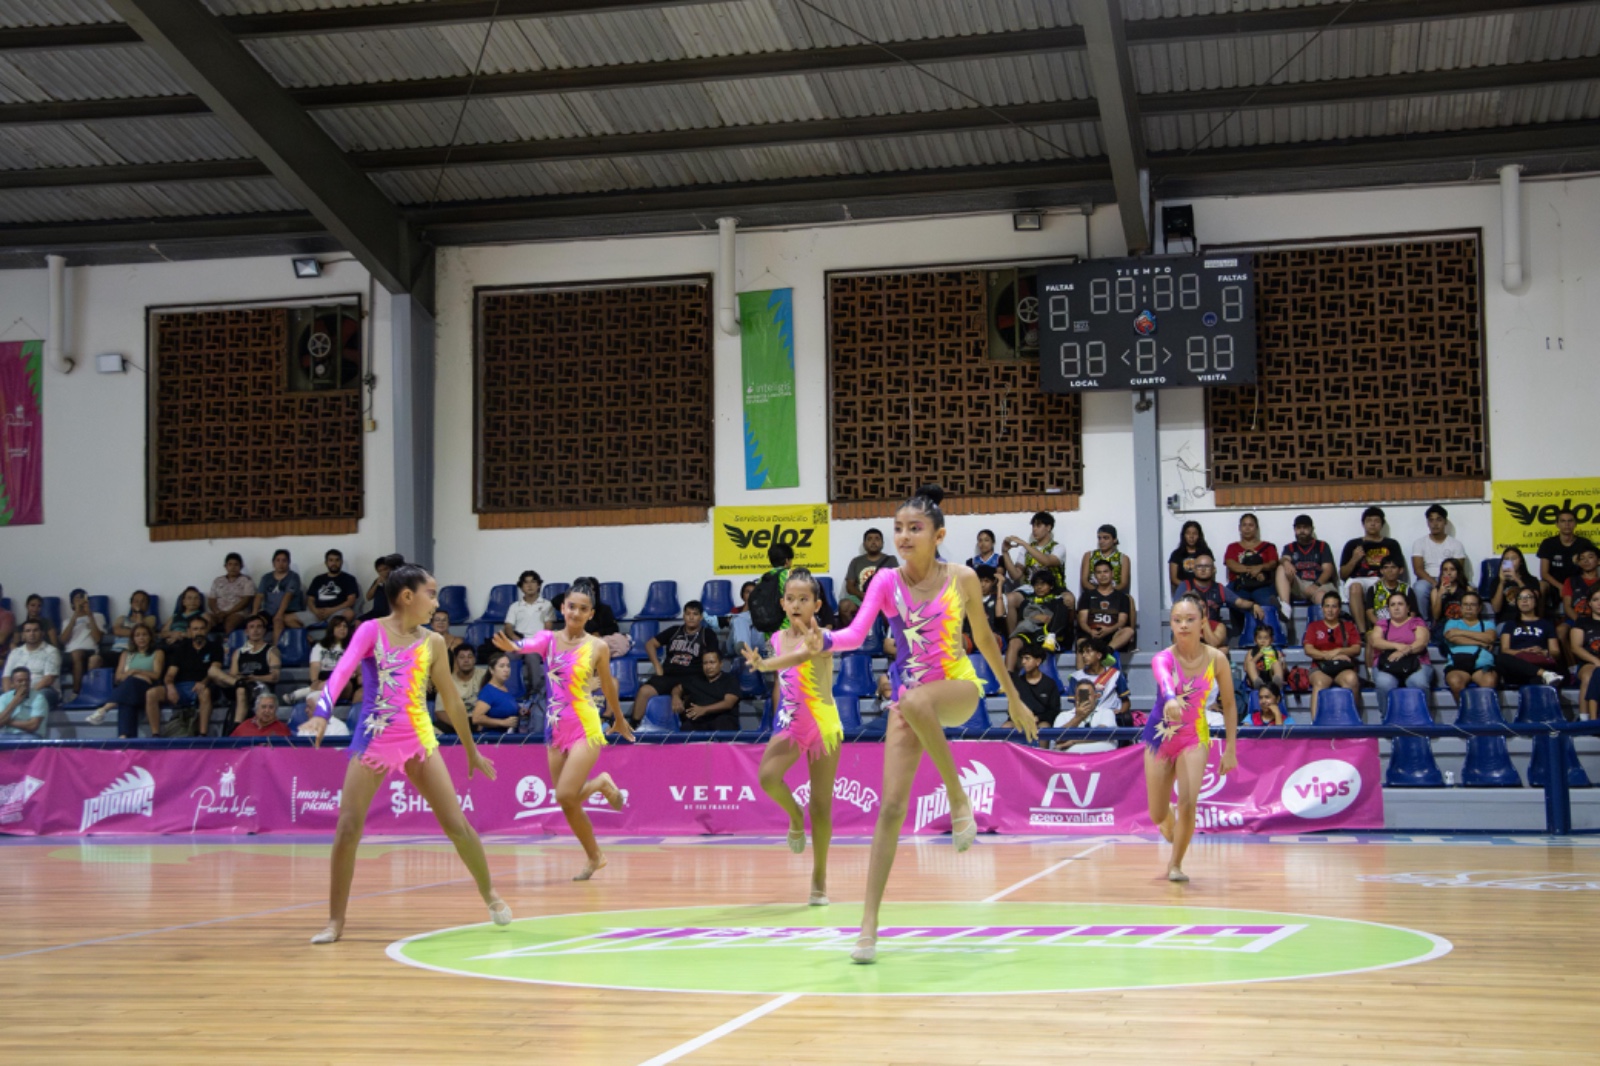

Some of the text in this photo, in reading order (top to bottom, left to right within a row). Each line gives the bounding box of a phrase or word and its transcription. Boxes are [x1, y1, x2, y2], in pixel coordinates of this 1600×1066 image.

[1117, 267, 1171, 276] TIEMPO
[1218, 273, 1247, 282] FALTAS
[1045, 283, 1075, 292] FALTAS
[1130, 377, 1167, 386] CUARTO
[1197, 374, 1228, 382] VISITA
[1069, 380, 1099, 388] LOCAL
[771, 514, 808, 522] Domicilio
[723, 523, 814, 549] veloz
[1093, 613, 1112, 624] 50
[297, 788, 331, 799] movie
[669, 785, 757, 801] VETA
[1041, 772, 1101, 807] AV
[1294, 776, 1350, 805] vips
[300, 800, 335, 815] picnic
[1030, 811, 1115, 823] acero vallarta
